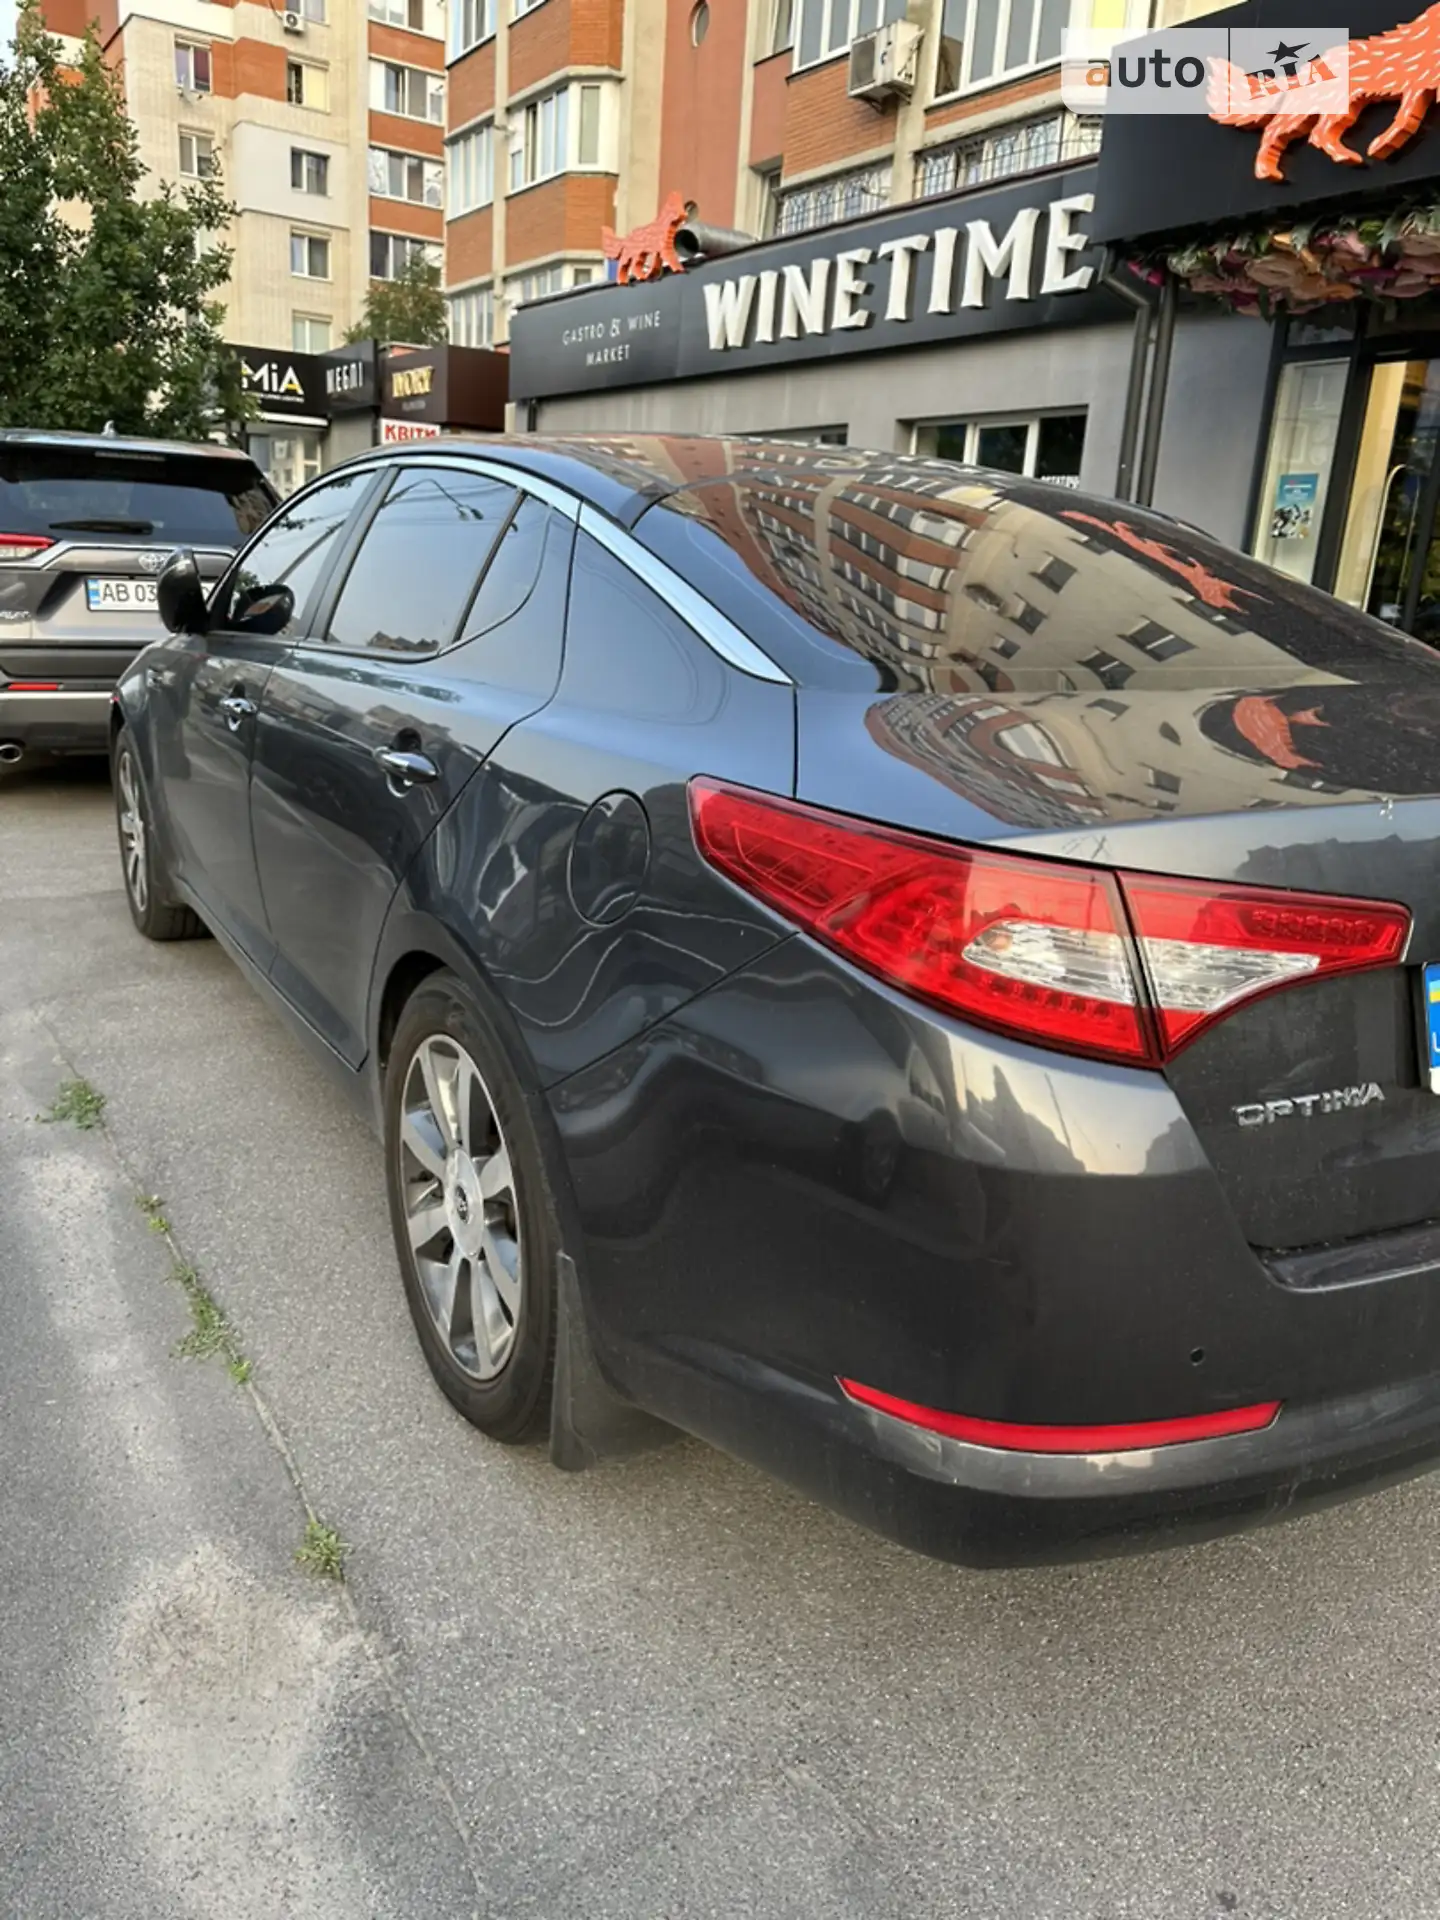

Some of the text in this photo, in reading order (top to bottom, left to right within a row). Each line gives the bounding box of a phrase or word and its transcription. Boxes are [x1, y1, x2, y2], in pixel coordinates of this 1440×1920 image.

[703, 193, 1096, 350] WINETIME
[562, 322, 605, 345] GASTRO
[627, 310, 660, 330] WINE
[586, 344, 630, 366] MARKET
[102, 582, 130, 602] AB
[1234, 1082, 1385, 1126] OPTIMA
